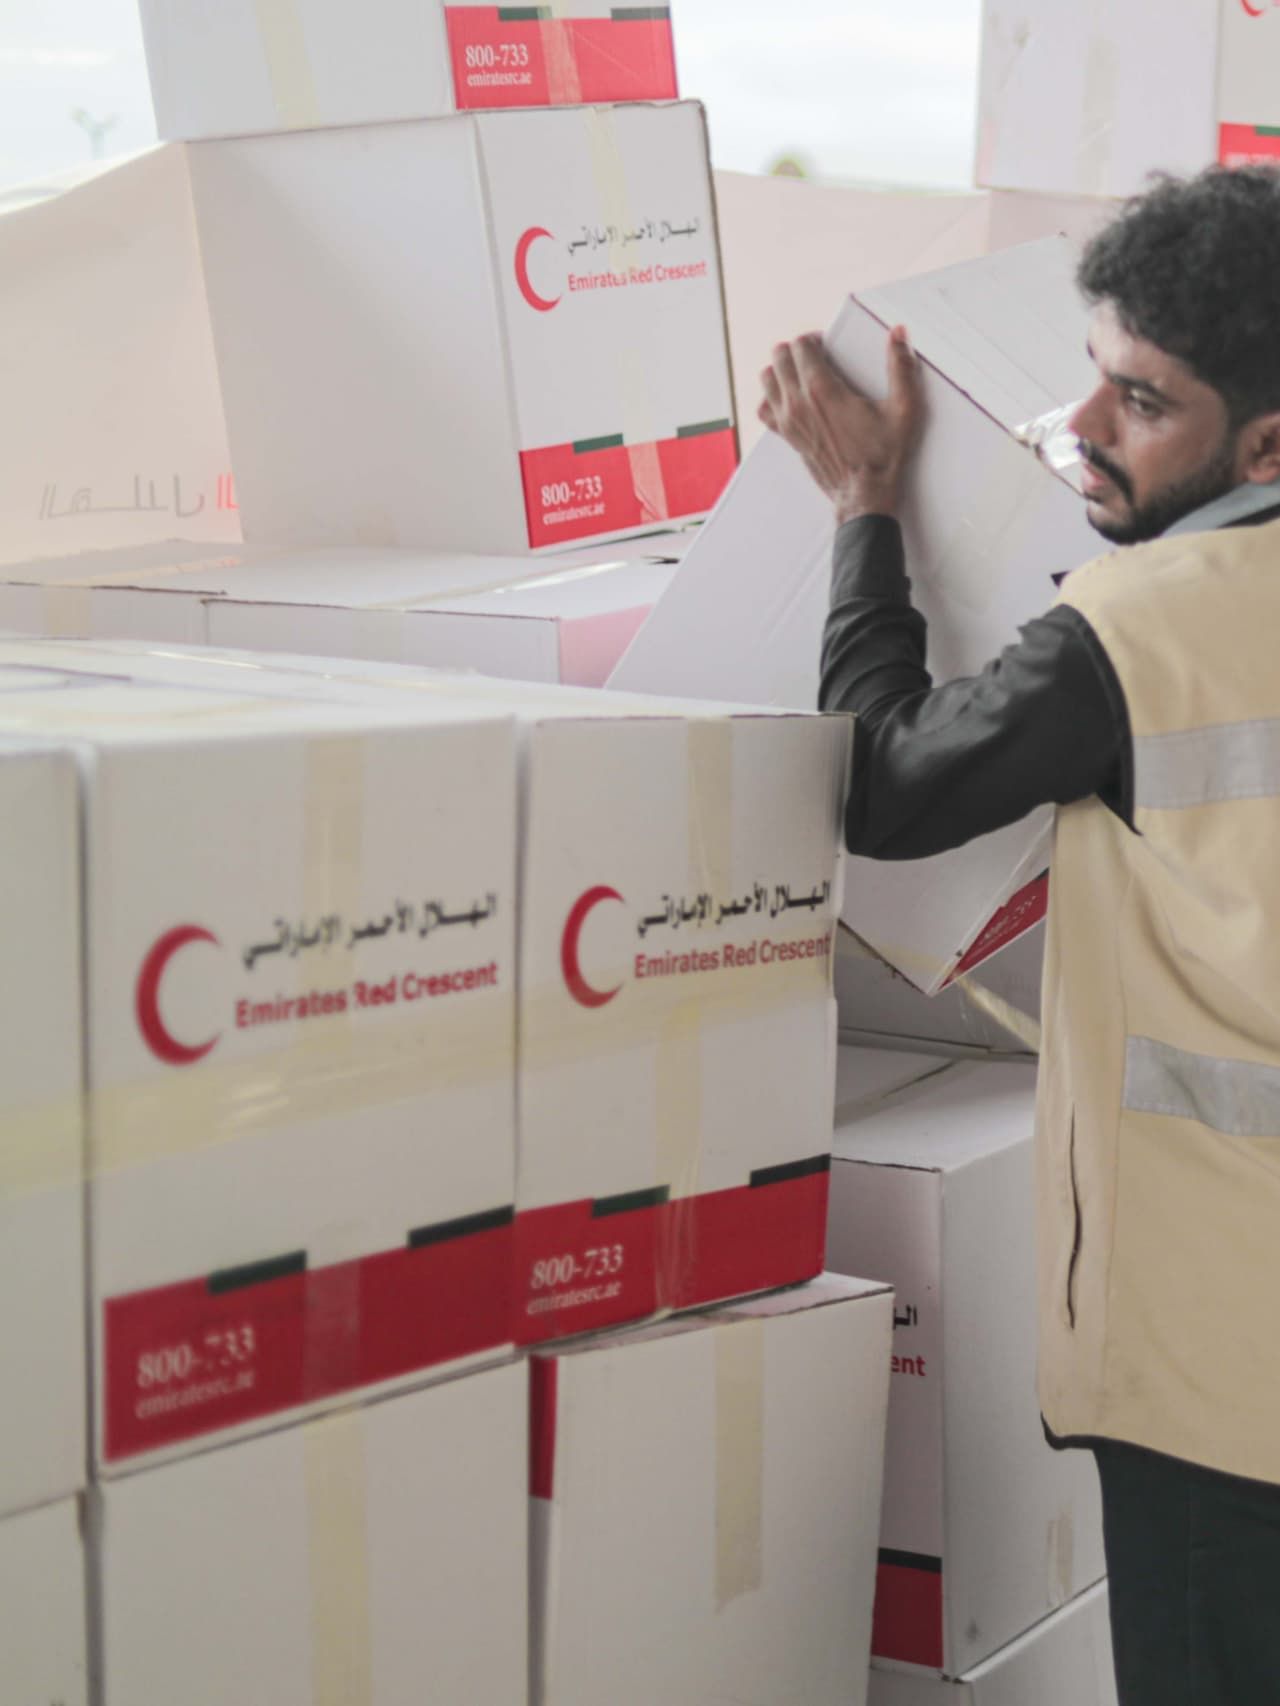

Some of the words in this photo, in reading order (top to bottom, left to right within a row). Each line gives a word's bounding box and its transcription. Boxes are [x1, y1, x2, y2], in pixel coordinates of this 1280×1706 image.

[466, 44, 529, 67] 800-733
[568, 272, 627, 292] Emirates
[630, 266, 652, 284] Red
[655, 261, 707, 281] Crescent
[541, 475, 603, 507] 800-733
[634, 948, 720, 979] Emirates
[723, 940, 757, 967] Red
[760, 932, 831, 964] Crescent
[235, 989, 348, 1029] Emirates
[354, 976, 397, 1008] Red
[401, 961, 498, 1002] Crescent
[530, 1244, 624, 1289] 800-733
[137, 1323, 255, 1388] 800-733
